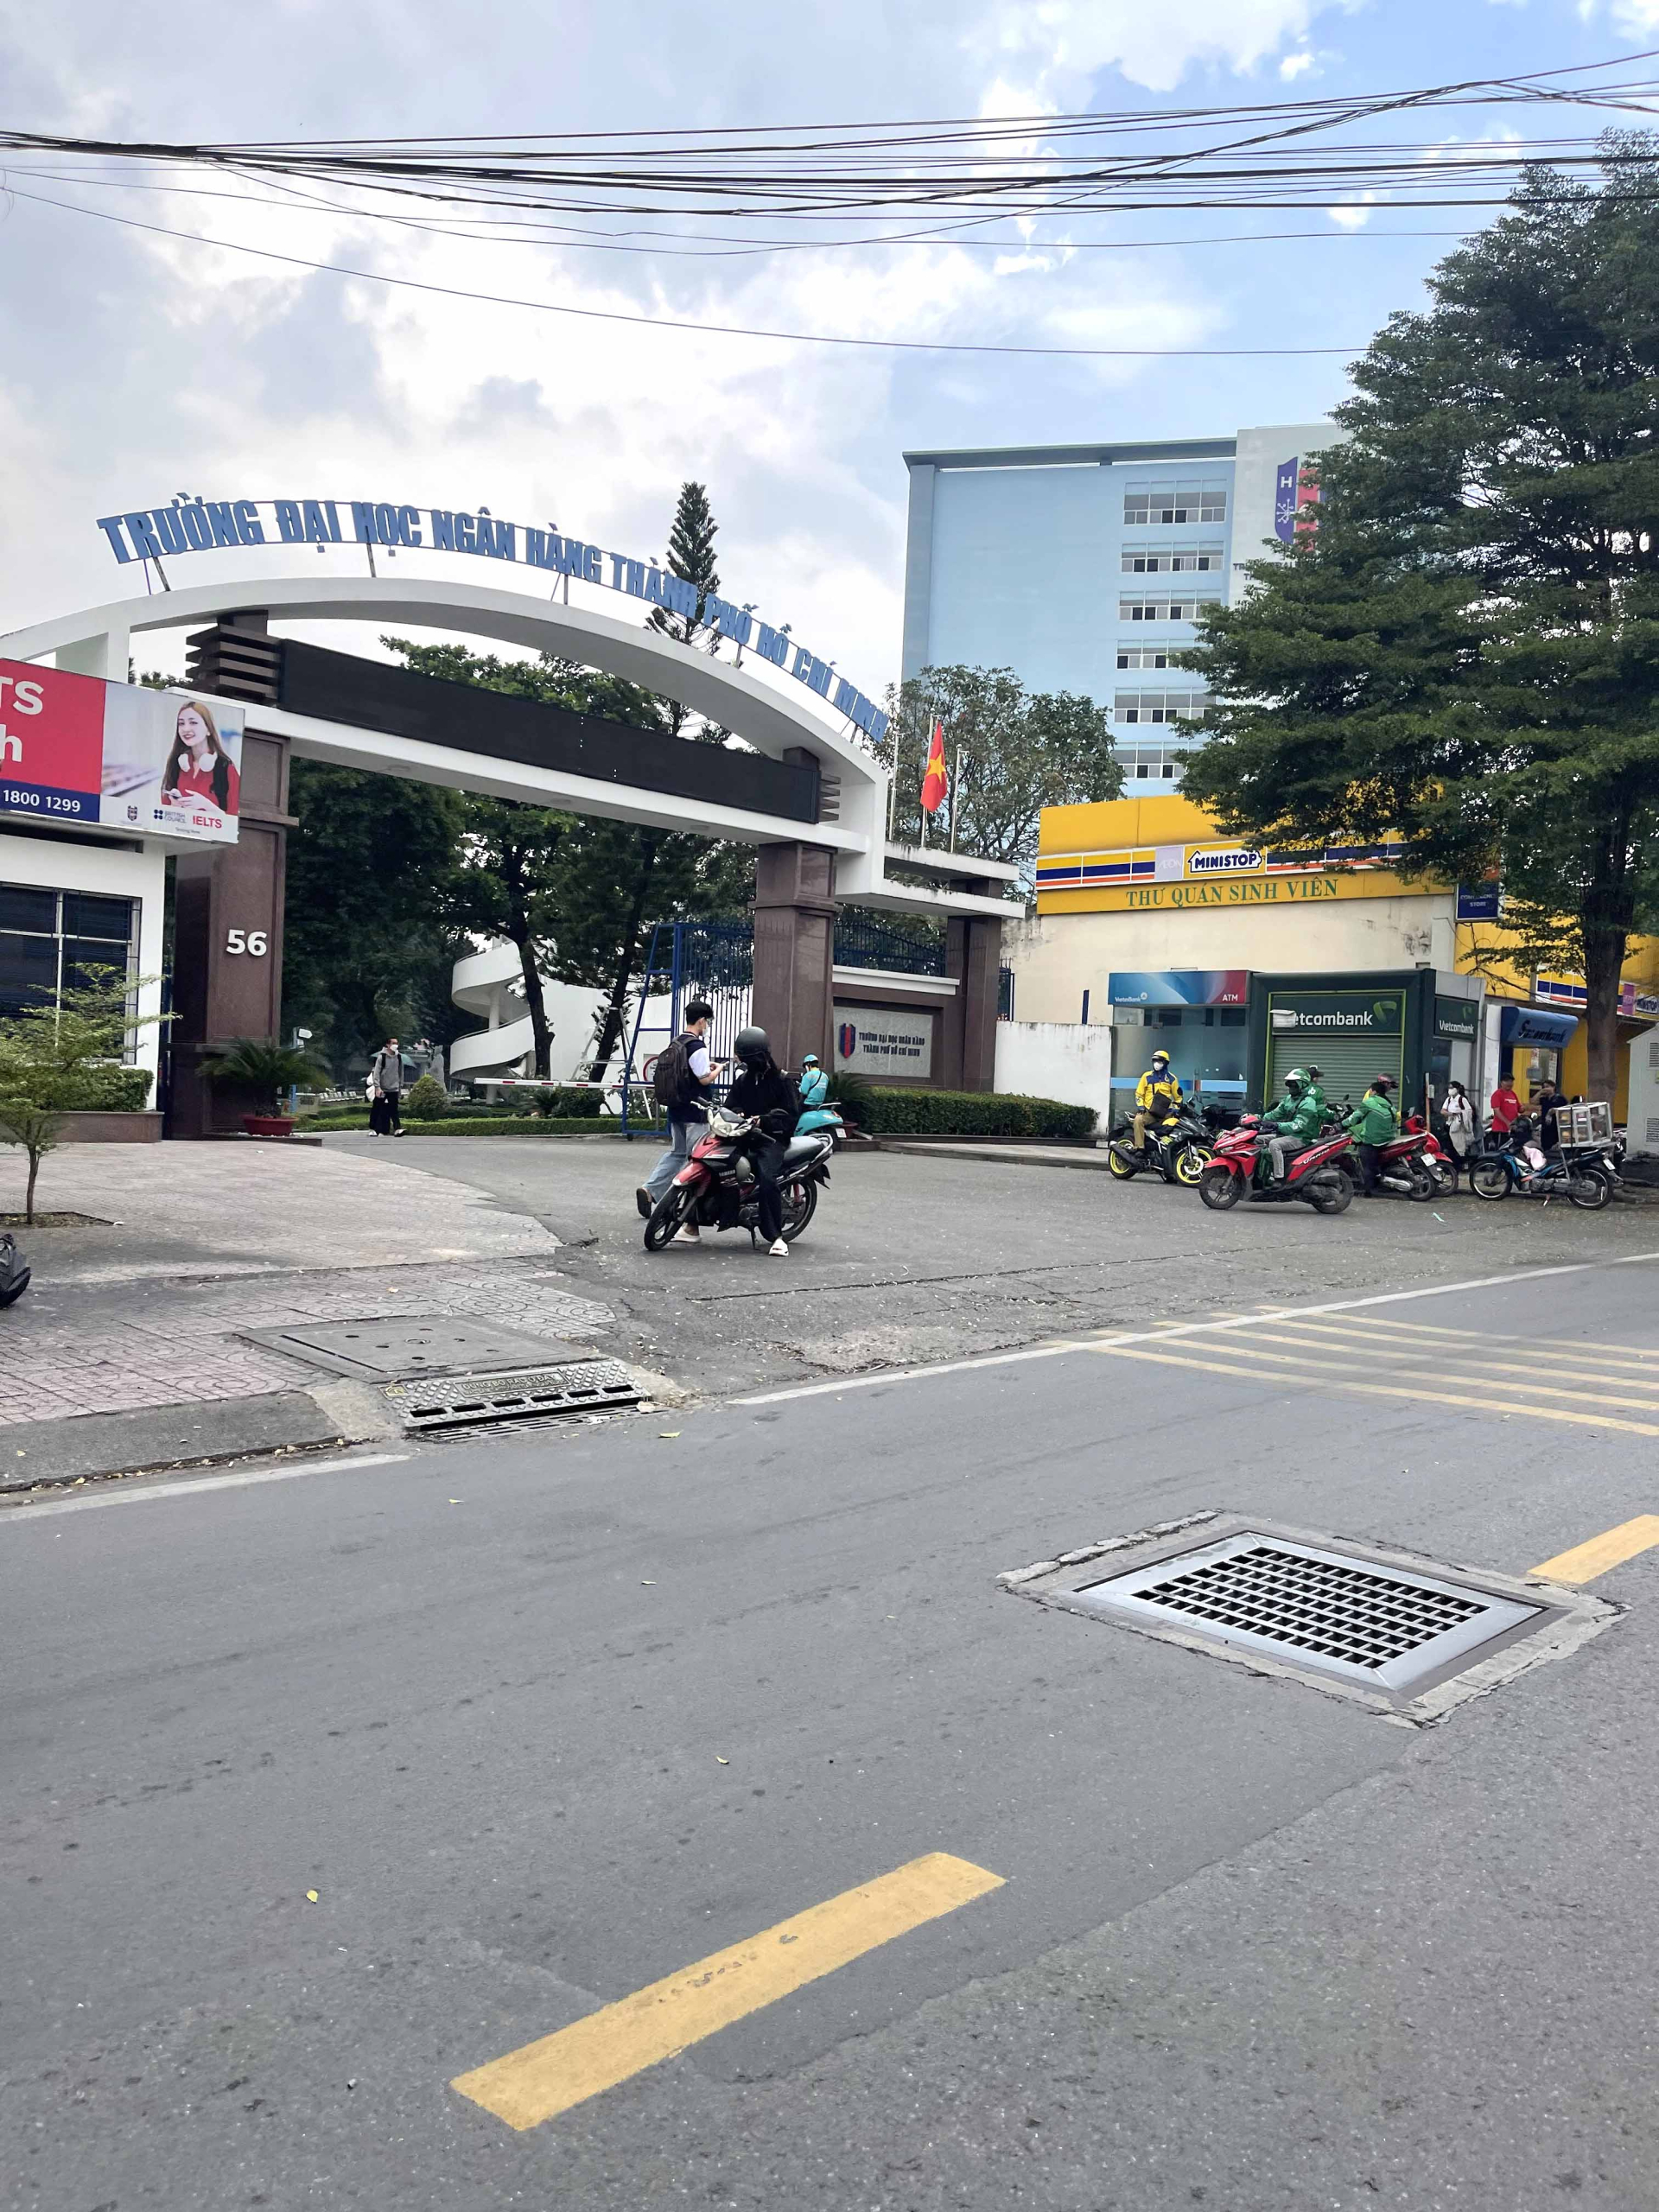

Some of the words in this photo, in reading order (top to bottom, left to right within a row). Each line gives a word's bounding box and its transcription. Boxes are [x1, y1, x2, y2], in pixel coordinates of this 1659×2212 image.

[96, 493, 264, 564] TRƯỜNG
[273, 499, 342, 553] ĐẠI
[351, 501, 422, 556] HỌC
[432, 507, 516, 562] NGÂN
[525, 522, 602, 583] HÀNG
[610, 552, 698, 620] THÀNH
[703, 593, 760, 645] PHỐ
[756, 623, 793, 667] HỒ
[792, 648, 837, 699] CHÍ
[832, 677, 890, 743] MINH
[3, 789, 40, 807] 1800
[46, 796, 80, 813] 1299
[193, 815, 222, 829] IELTS
[1194, 853, 1257, 869] MINISTOP
[1126, 887, 1166, 906] THƯ
[1172, 883, 1223, 907] QUÁN
[1229, 882, 1278, 901] SINH
[1286, 876, 1339, 898] VIÊN
[225, 928, 268, 957] 56
[1439, 1020, 1475, 1034] Vietcombank
